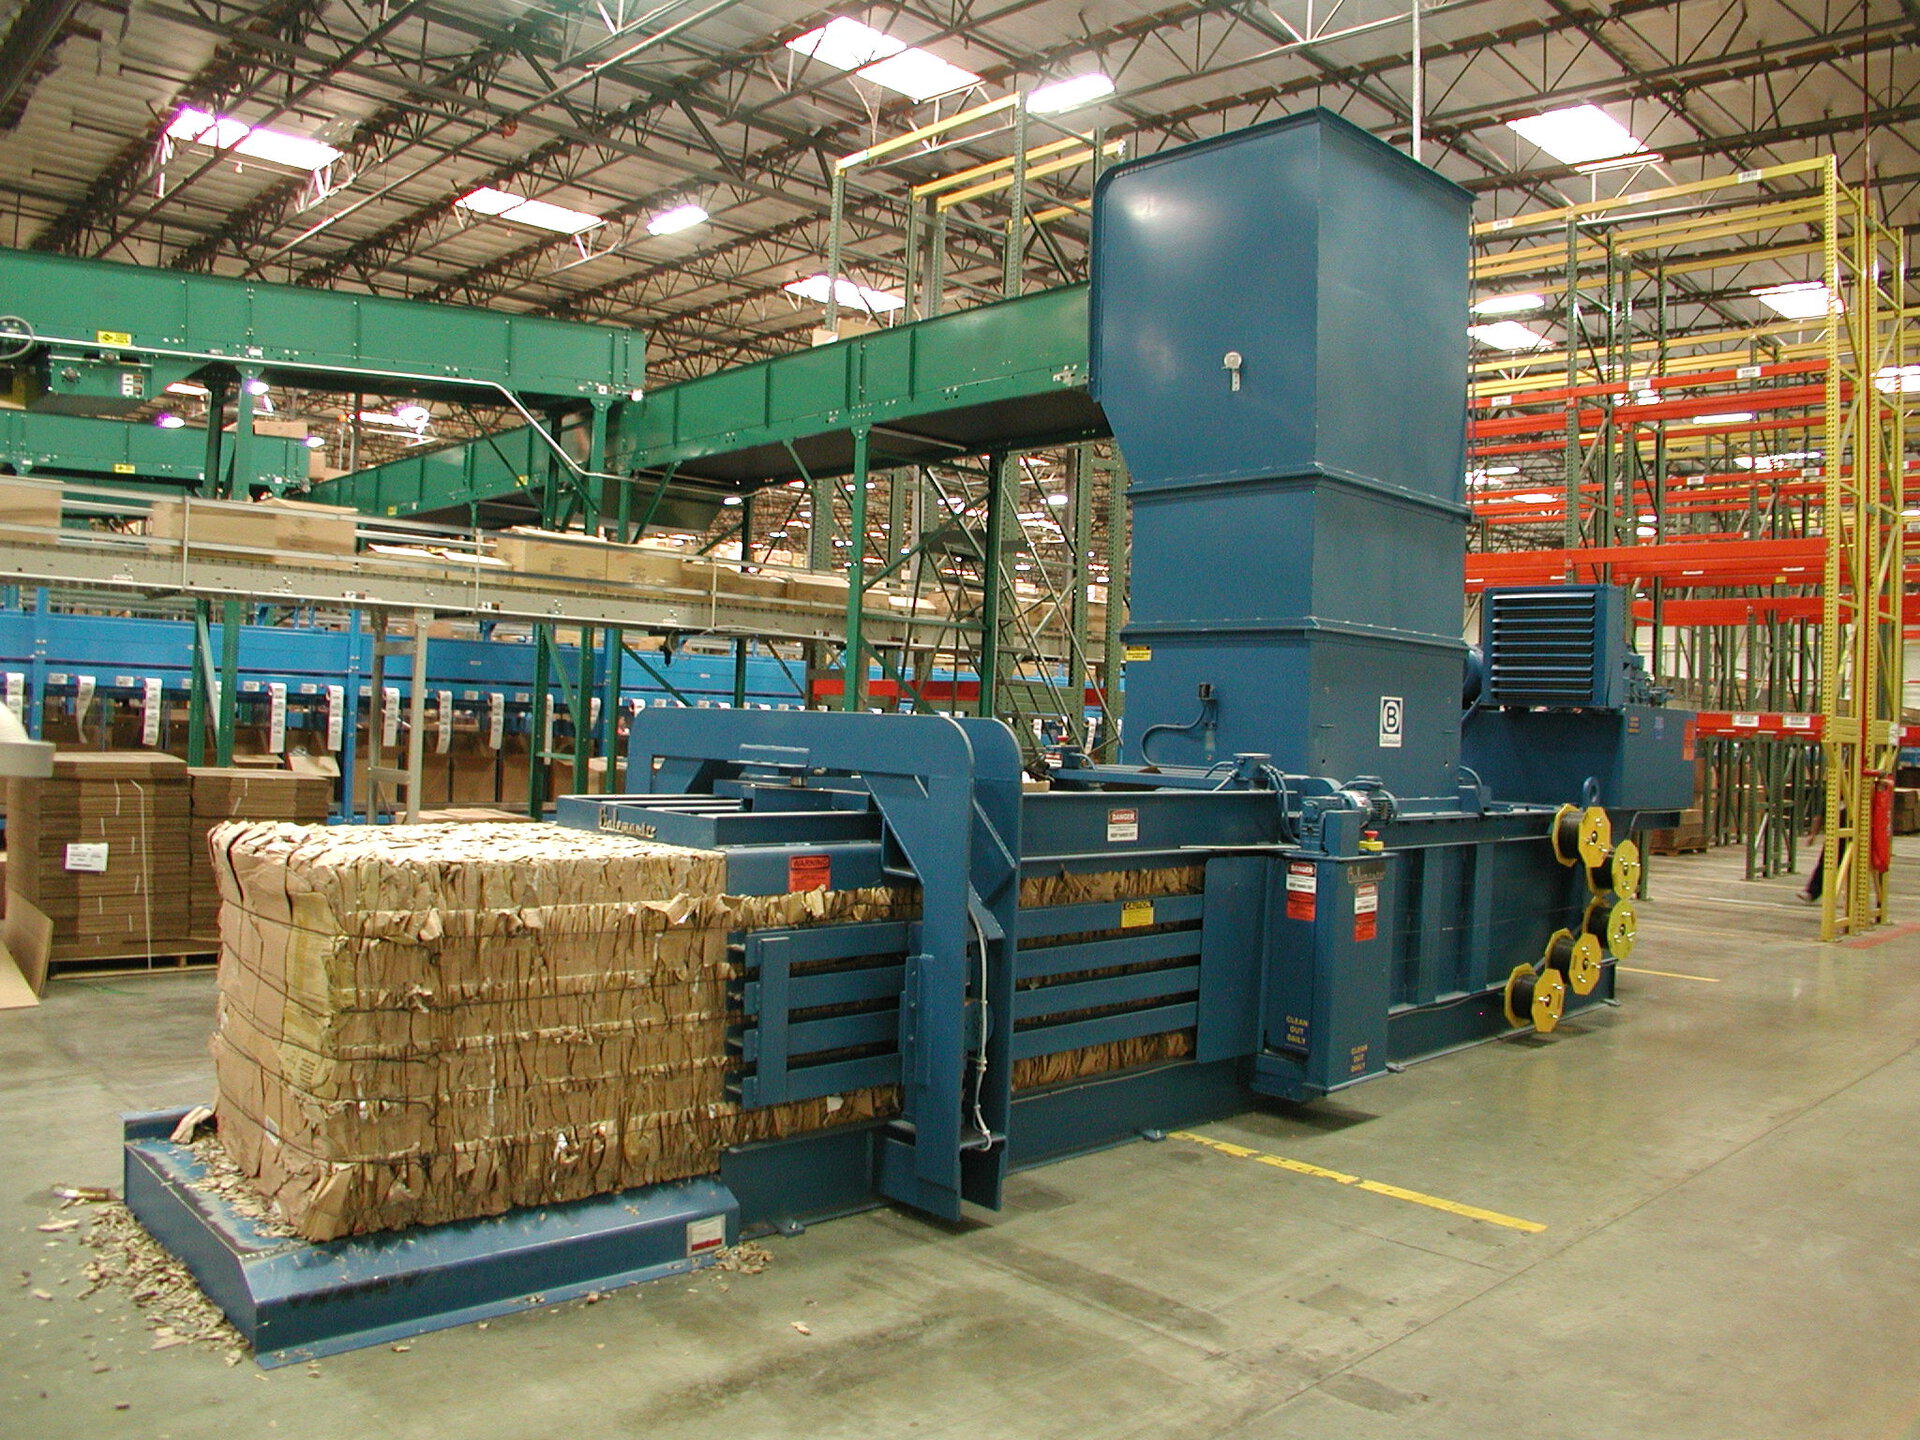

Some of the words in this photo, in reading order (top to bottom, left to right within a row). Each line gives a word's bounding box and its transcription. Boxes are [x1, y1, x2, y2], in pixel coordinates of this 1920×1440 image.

[1387, 706, 1397, 727] B
[1112, 813, 1135, 821] DANGER
[793, 858, 829, 868] WARNING
[1124, 900, 1151, 910] CAUTION
[1285, 1015, 1309, 1027] CLEAN
[1290, 1025, 1304, 1035] OUT
[1286, 1034, 1306, 1045] DAILY
